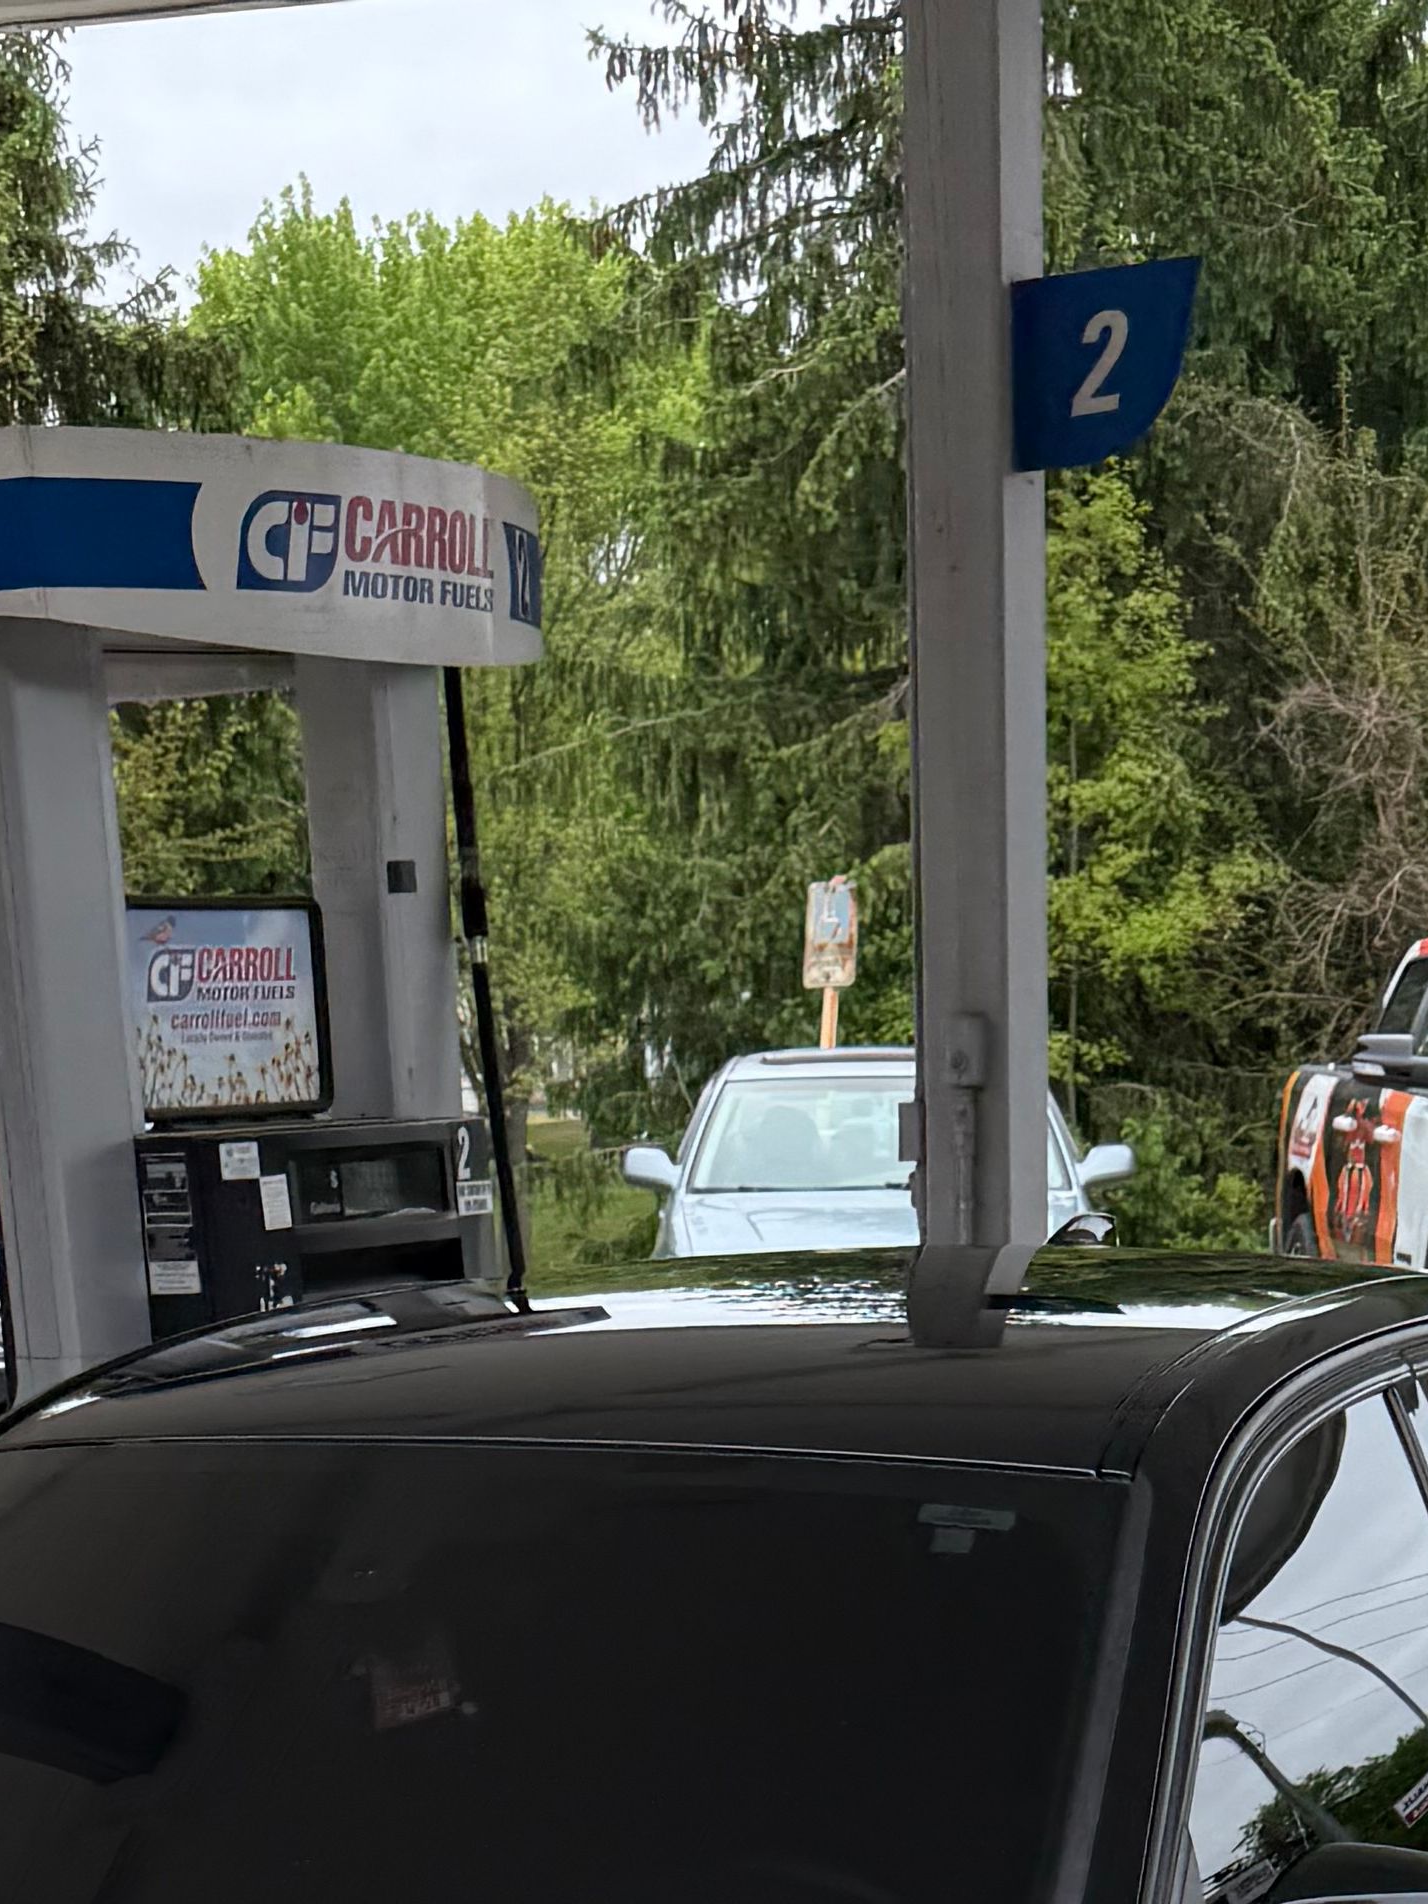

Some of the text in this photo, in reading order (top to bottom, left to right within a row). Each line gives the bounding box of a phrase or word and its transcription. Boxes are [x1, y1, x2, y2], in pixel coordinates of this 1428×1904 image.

[1070, 310, 1128, 417] 2
[344, 495, 495, 579] CARROLL
[343, 569, 494, 612] MOTOR FUELS
[197, 946, 296, 982] CARROLL
[196, 985, 295, 1001] MOTOR FUELS
[171, 1008, 281, 1030] carrollfuel.com
[457, 1126, 471, 1180] 2
